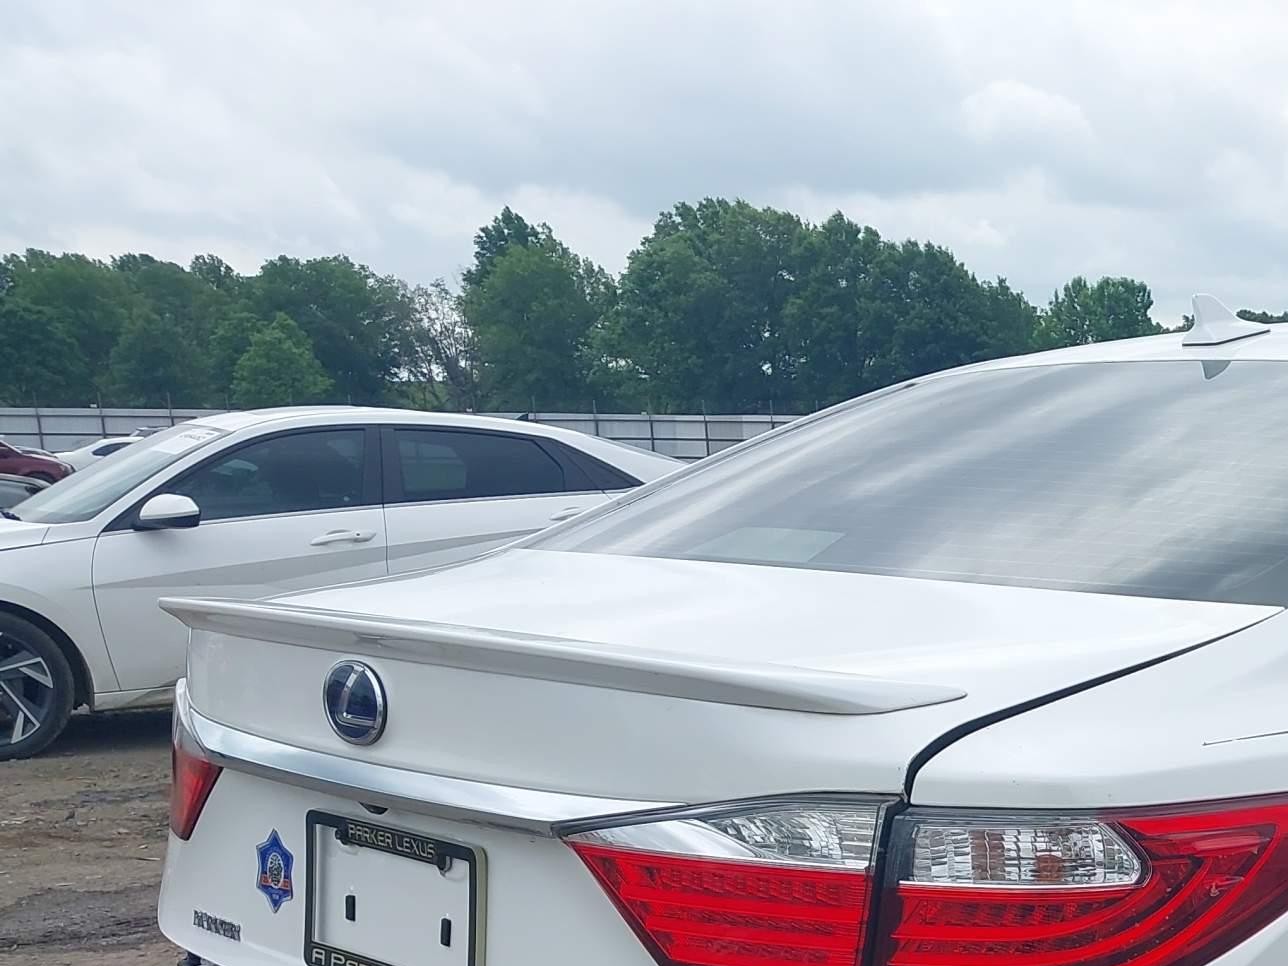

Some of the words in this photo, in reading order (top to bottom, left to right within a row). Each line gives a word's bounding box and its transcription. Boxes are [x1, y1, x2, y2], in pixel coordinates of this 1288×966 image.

[348, 824, 393, 848] PARKER
[395, 836, 436, 858] LEXUS
[312, 949, 325, 965] A
